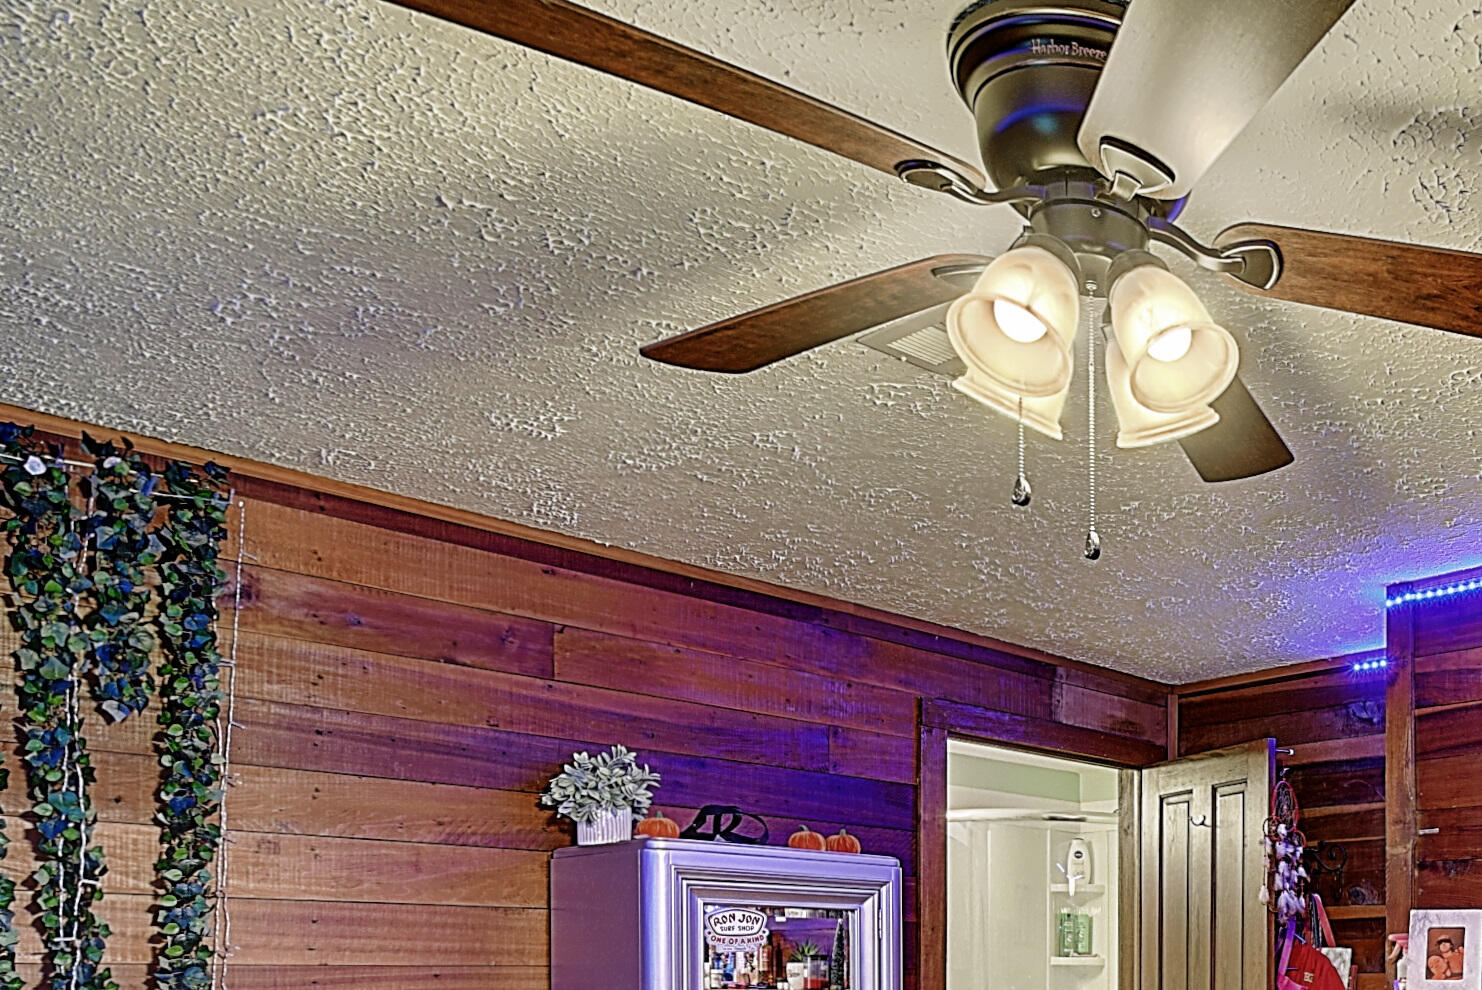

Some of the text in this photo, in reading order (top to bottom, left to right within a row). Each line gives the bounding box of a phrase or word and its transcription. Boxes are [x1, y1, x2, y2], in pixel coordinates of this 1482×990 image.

[1031, 39, 1107, 62] Harbor Breeze
[714, 913, 760, 927] RON JON
[711, 935, 726, 944] ONE
